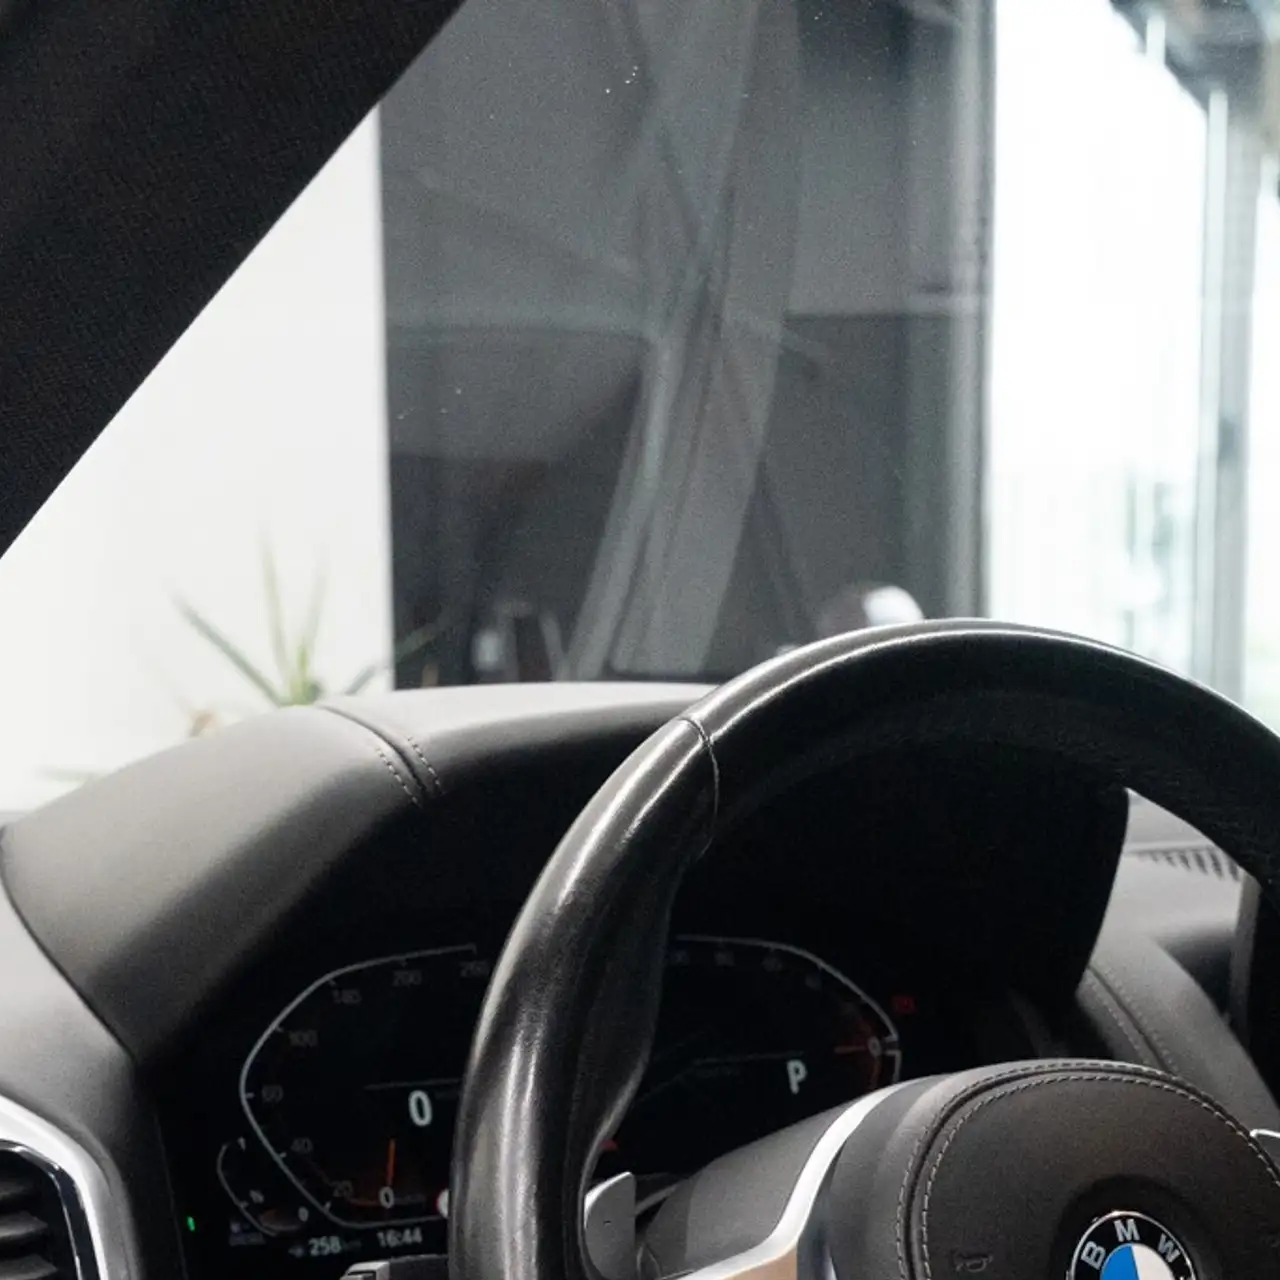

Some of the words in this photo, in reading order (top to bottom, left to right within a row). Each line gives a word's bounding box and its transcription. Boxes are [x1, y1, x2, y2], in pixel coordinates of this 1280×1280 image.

[786, 1059, 809, 1096] P
[407, 1090, 433, 1127] 0
[378, 1186, 396, 1210] 0
[308, 1236, 344, 1257] 258
[1081, 1218, 1180, 1270] BMW
